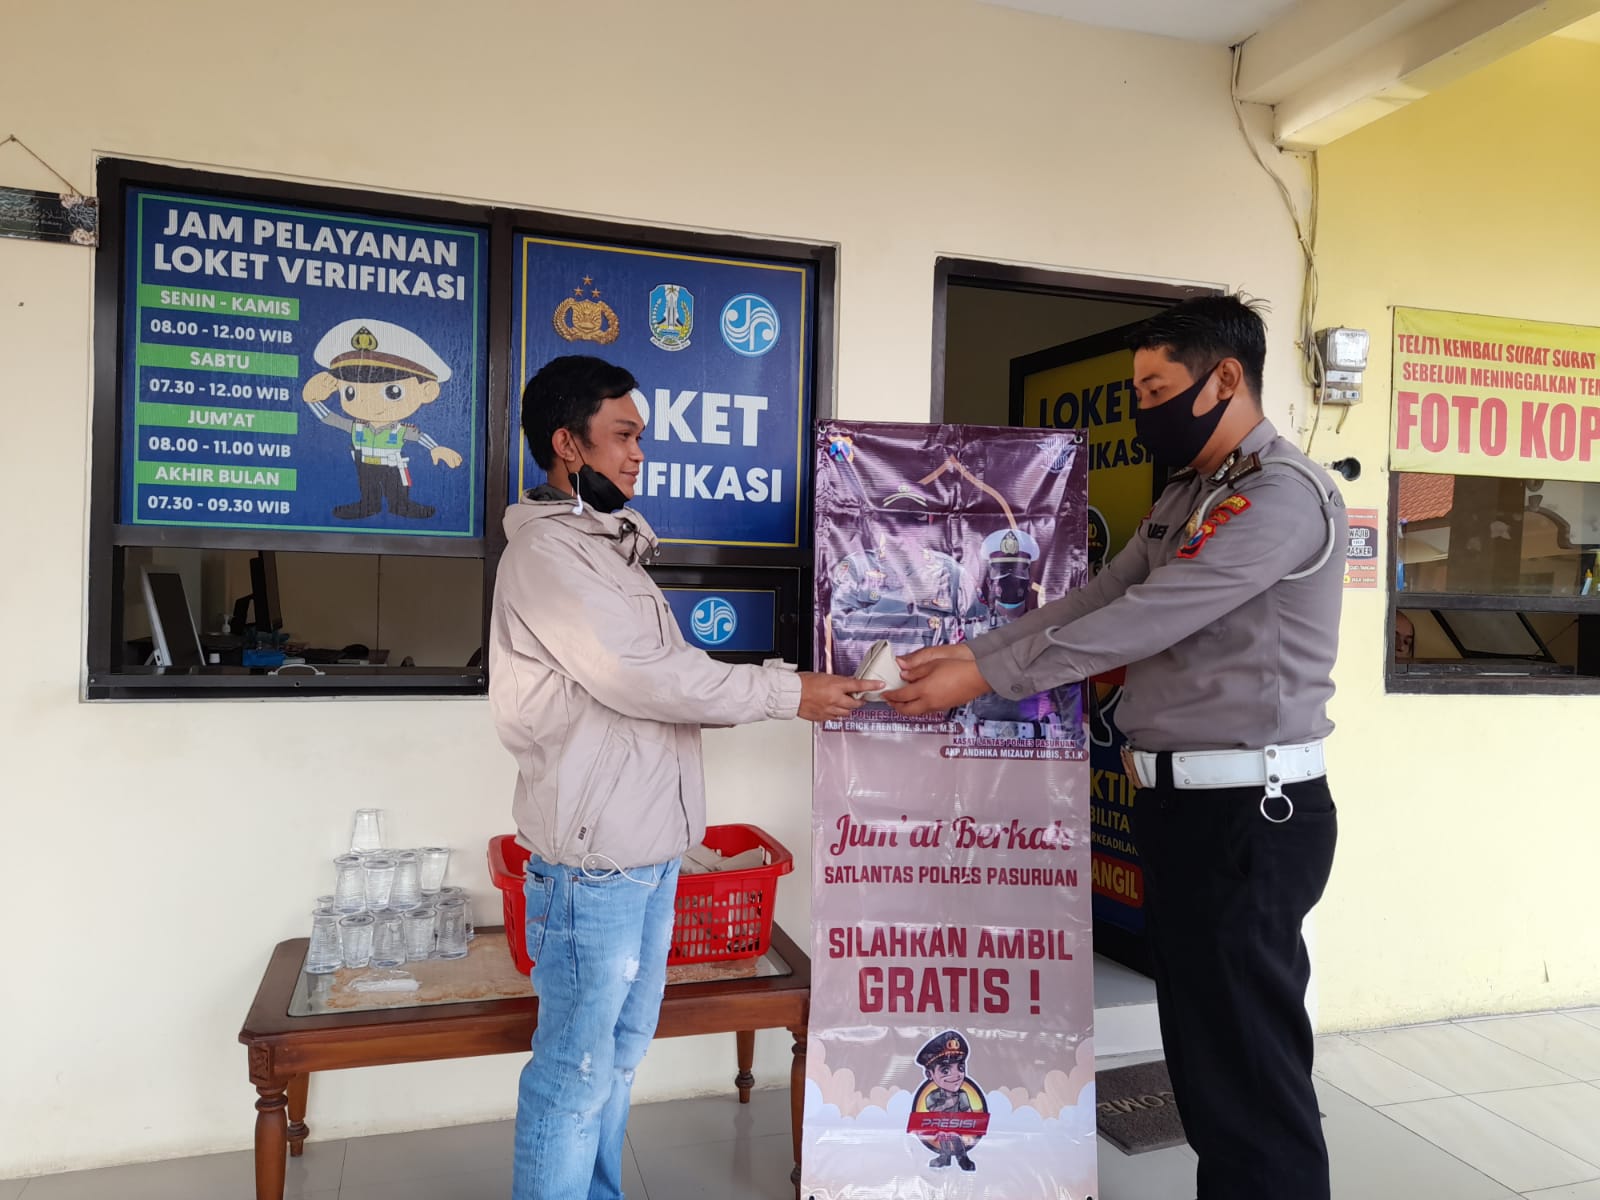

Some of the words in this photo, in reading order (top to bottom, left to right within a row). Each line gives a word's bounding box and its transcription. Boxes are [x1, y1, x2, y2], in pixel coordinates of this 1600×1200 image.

[163, 209, 243, 244] JAM
[253, 218, 457, 267] PELAYANAN
[154, 243, 268, 280] LOKET
[277, 257, 464, 300] VERIFIKASI
[160, 290, 215, 309] SENIN
[231, 297, 291, 315] KAMIS
[150, 319, 198, 336] 08.00
[213, 325, 256, 342] 12.00
[259, 329, 293, 344] WIB
[190, 351, 250, 369] SABTU
[1397, 333, 1440, 356] TELITI
[1443, 338, 1502, 362] KEMBALI
[1506, 343, 1550, 366] SURAT
[1553, 348, 1596, 370] SURAT
[1403, 361, 1467, 385] SEBELUM
[1470, 368, 1576, 394] MENINGGALKAN
[149, 379, 195, 395] 07.30
[209, 383, 252, 399] 12.00
[256, 386, 290, 401] WIB
[187, 410, 255, 428] JUM'AT
[629, 388, 768, 447] KET
[1396, 390, 1508, 457] FOTO
[149, 436, 198, 453] 08.00
[213, 440, 254, 456] 11.00
[258, 443, 291, 458] WIB
[155, 466, 214, 483] AKHIR
[218, 469, 280, 486] BULAN
[147, 495, 193, 511] 07.30
[207, 497, 253, 513] 09.30
[257, 501, 290, 515] WIB
[844, 722, 869, 732] ERICK
[962, 749, 998, 758] ANDHIKA
[1000, 750, 1034, 759] MIZALDY
[1006, 739, 1034, 748] POLRES
[1036, 739, 1076, 749] PASURUAN
[829, 813, 943, 856] Jum'at
[824, 865, 914, 885] SATLANTAS
[918, 866, 982, 885] POLRES
[987, 867, 1078, 888] PASURUAN
[829, 927, 967, 959] SILAHKAN
[977, 929, 1073, 961] AMBIL
[858, 966, 1009, 1014] GRATIS
[1030, 969, 1041, 1015] !
[921, 1118, 977, 1129] PRESISI
